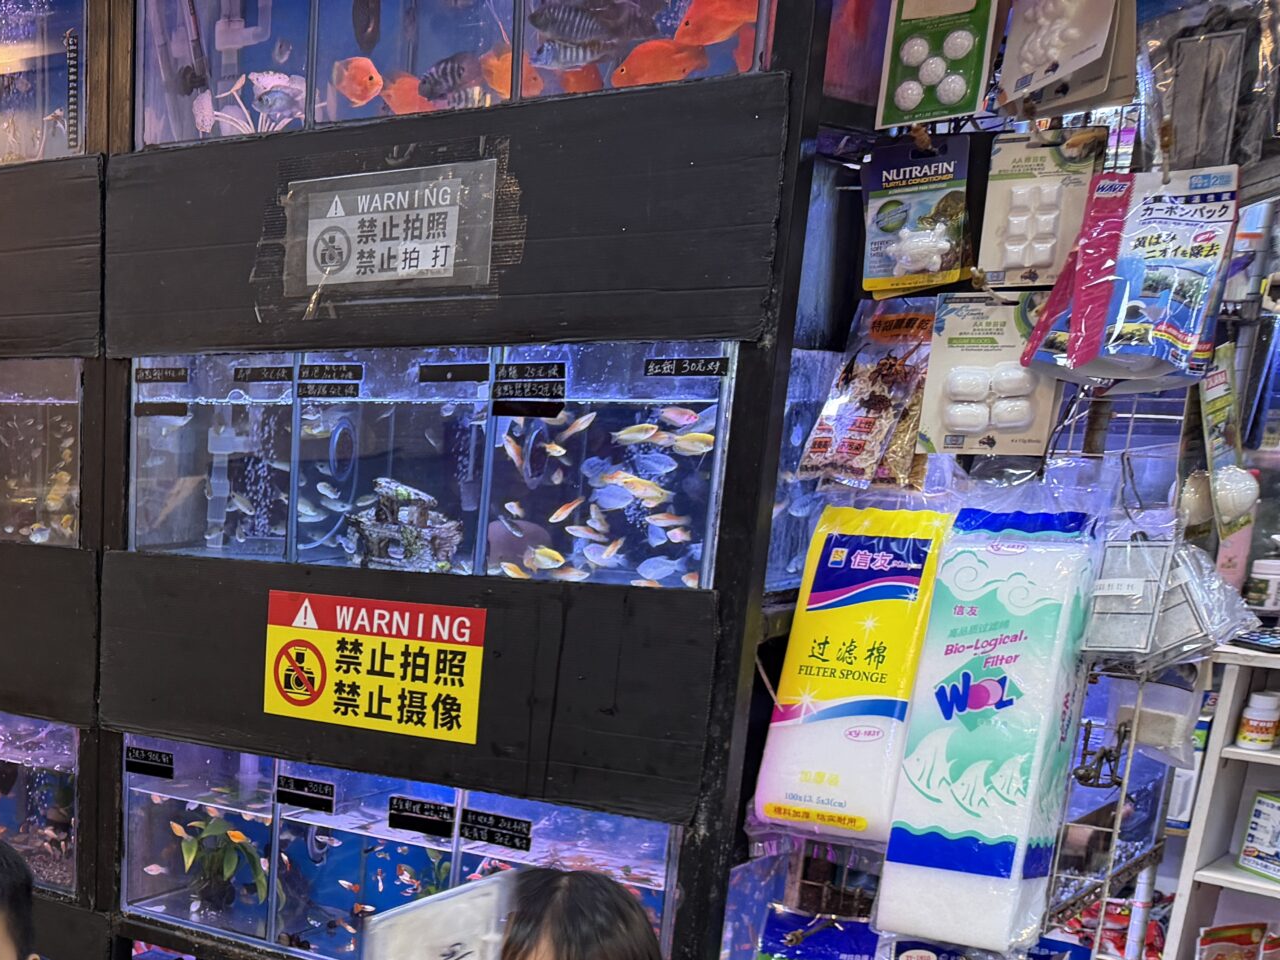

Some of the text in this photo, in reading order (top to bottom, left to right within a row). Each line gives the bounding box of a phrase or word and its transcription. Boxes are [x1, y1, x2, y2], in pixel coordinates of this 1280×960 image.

[882, 161, 954, 182] NUTRAFIN
[882, 181, 907, 189] TURTLE
[908, 174, 953, 185] CONDITIONER
[1096, 183, 1128, 193] WAVE
[357, 186, 452, 212] WARNING
[1141, 204, 1229, 219] カーボンパック
[357, 212, 449, 245] 禁止拍照
[1143, 243, 1220, 260] ニオイを除去
[851, 550, 894, 571] 信友
[954, 605, 978, 617] 信友
[336, 605, 472, 642] WARNING
[334, 638, 467, 687] 禁止拍照
[808, 636, 888, 670] 过滤棉
[984, 654, 1020, 668] Filter
[798, 665, 888, 683] FILTER SPONGE
[333, 680, 463, 731] 禁止摄像
